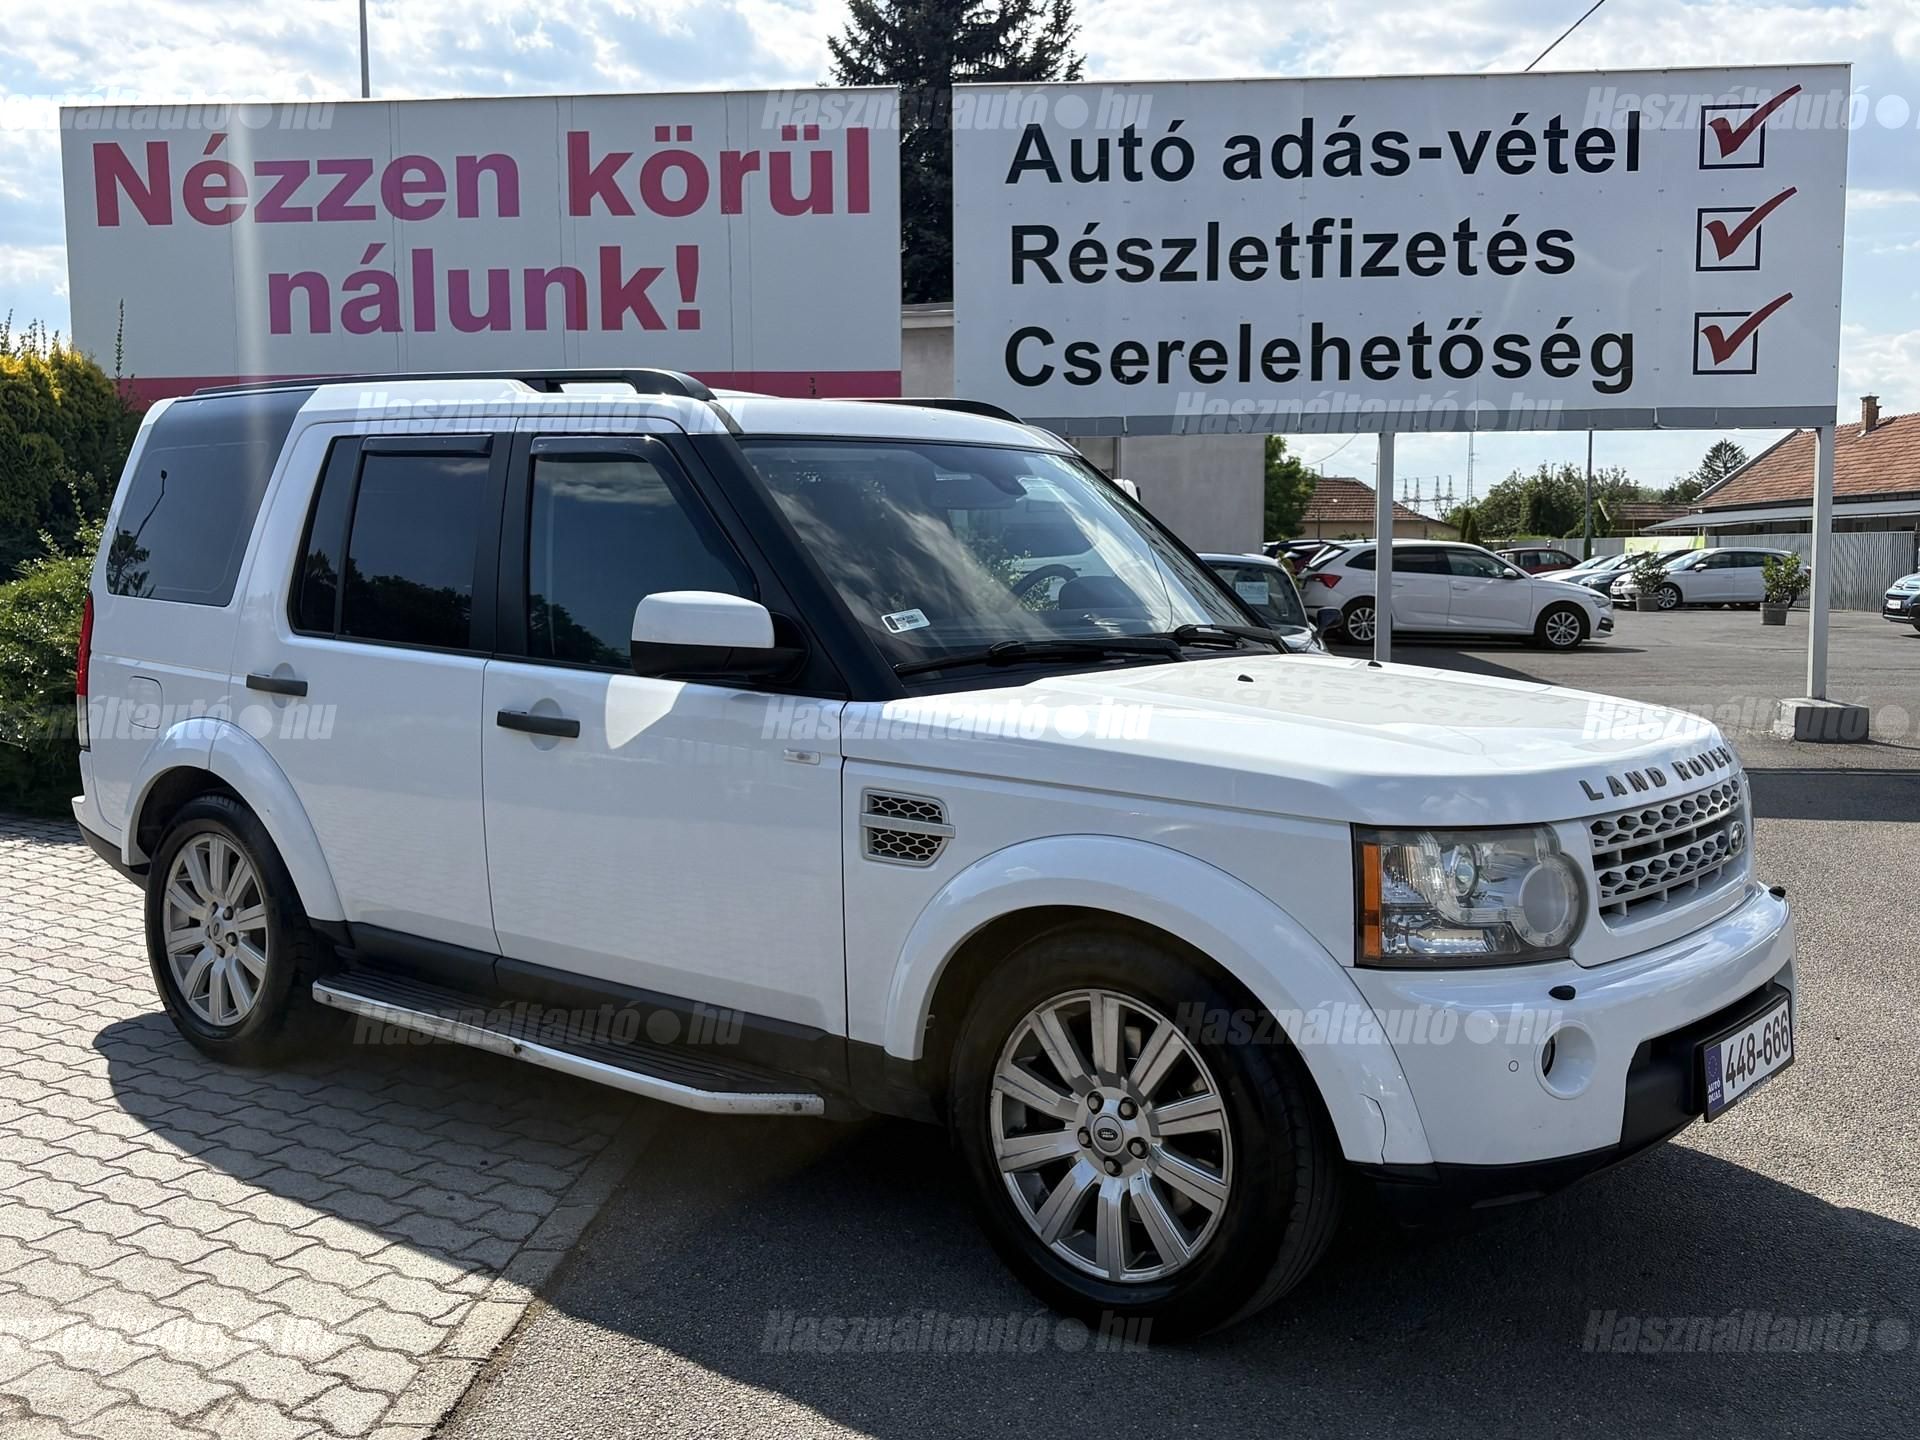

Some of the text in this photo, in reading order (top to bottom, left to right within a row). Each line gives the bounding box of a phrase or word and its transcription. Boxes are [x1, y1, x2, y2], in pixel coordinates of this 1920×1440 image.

[92, 124, 871, 227] Nézzen körül
[1005, 110, 1641, 184] Autó adás-vétel
[1011, 214, 1575, 285] Részletfizetés
[268, 243, 702, 336] nálunk!
[1005, 316, 1634, 395] Cserelehetőség
[1579, 746, 1733, 801] LAND ROVER
[1725, 1010, 1789, 1089] 448-666
